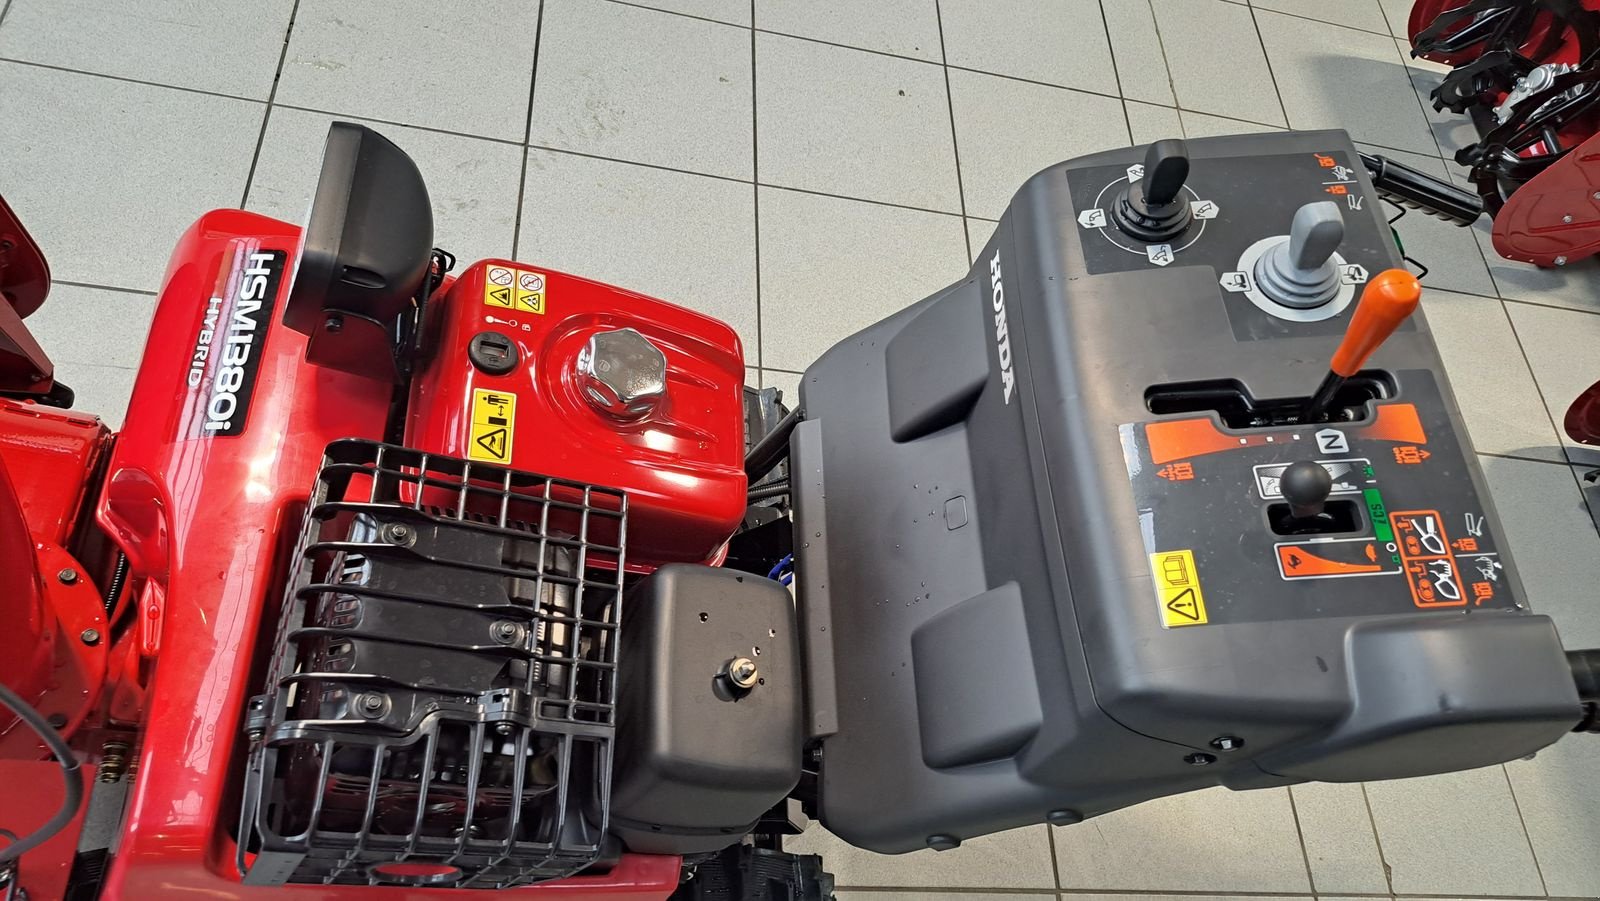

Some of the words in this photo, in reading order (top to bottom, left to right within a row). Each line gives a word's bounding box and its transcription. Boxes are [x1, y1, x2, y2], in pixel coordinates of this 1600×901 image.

[188, 297, 222, 388] HYBRID
[205, 253, 275, 431] HSM1380i
[990, 248, 1017, 405] HONDA
[1321, 434, 1344, 450] N
